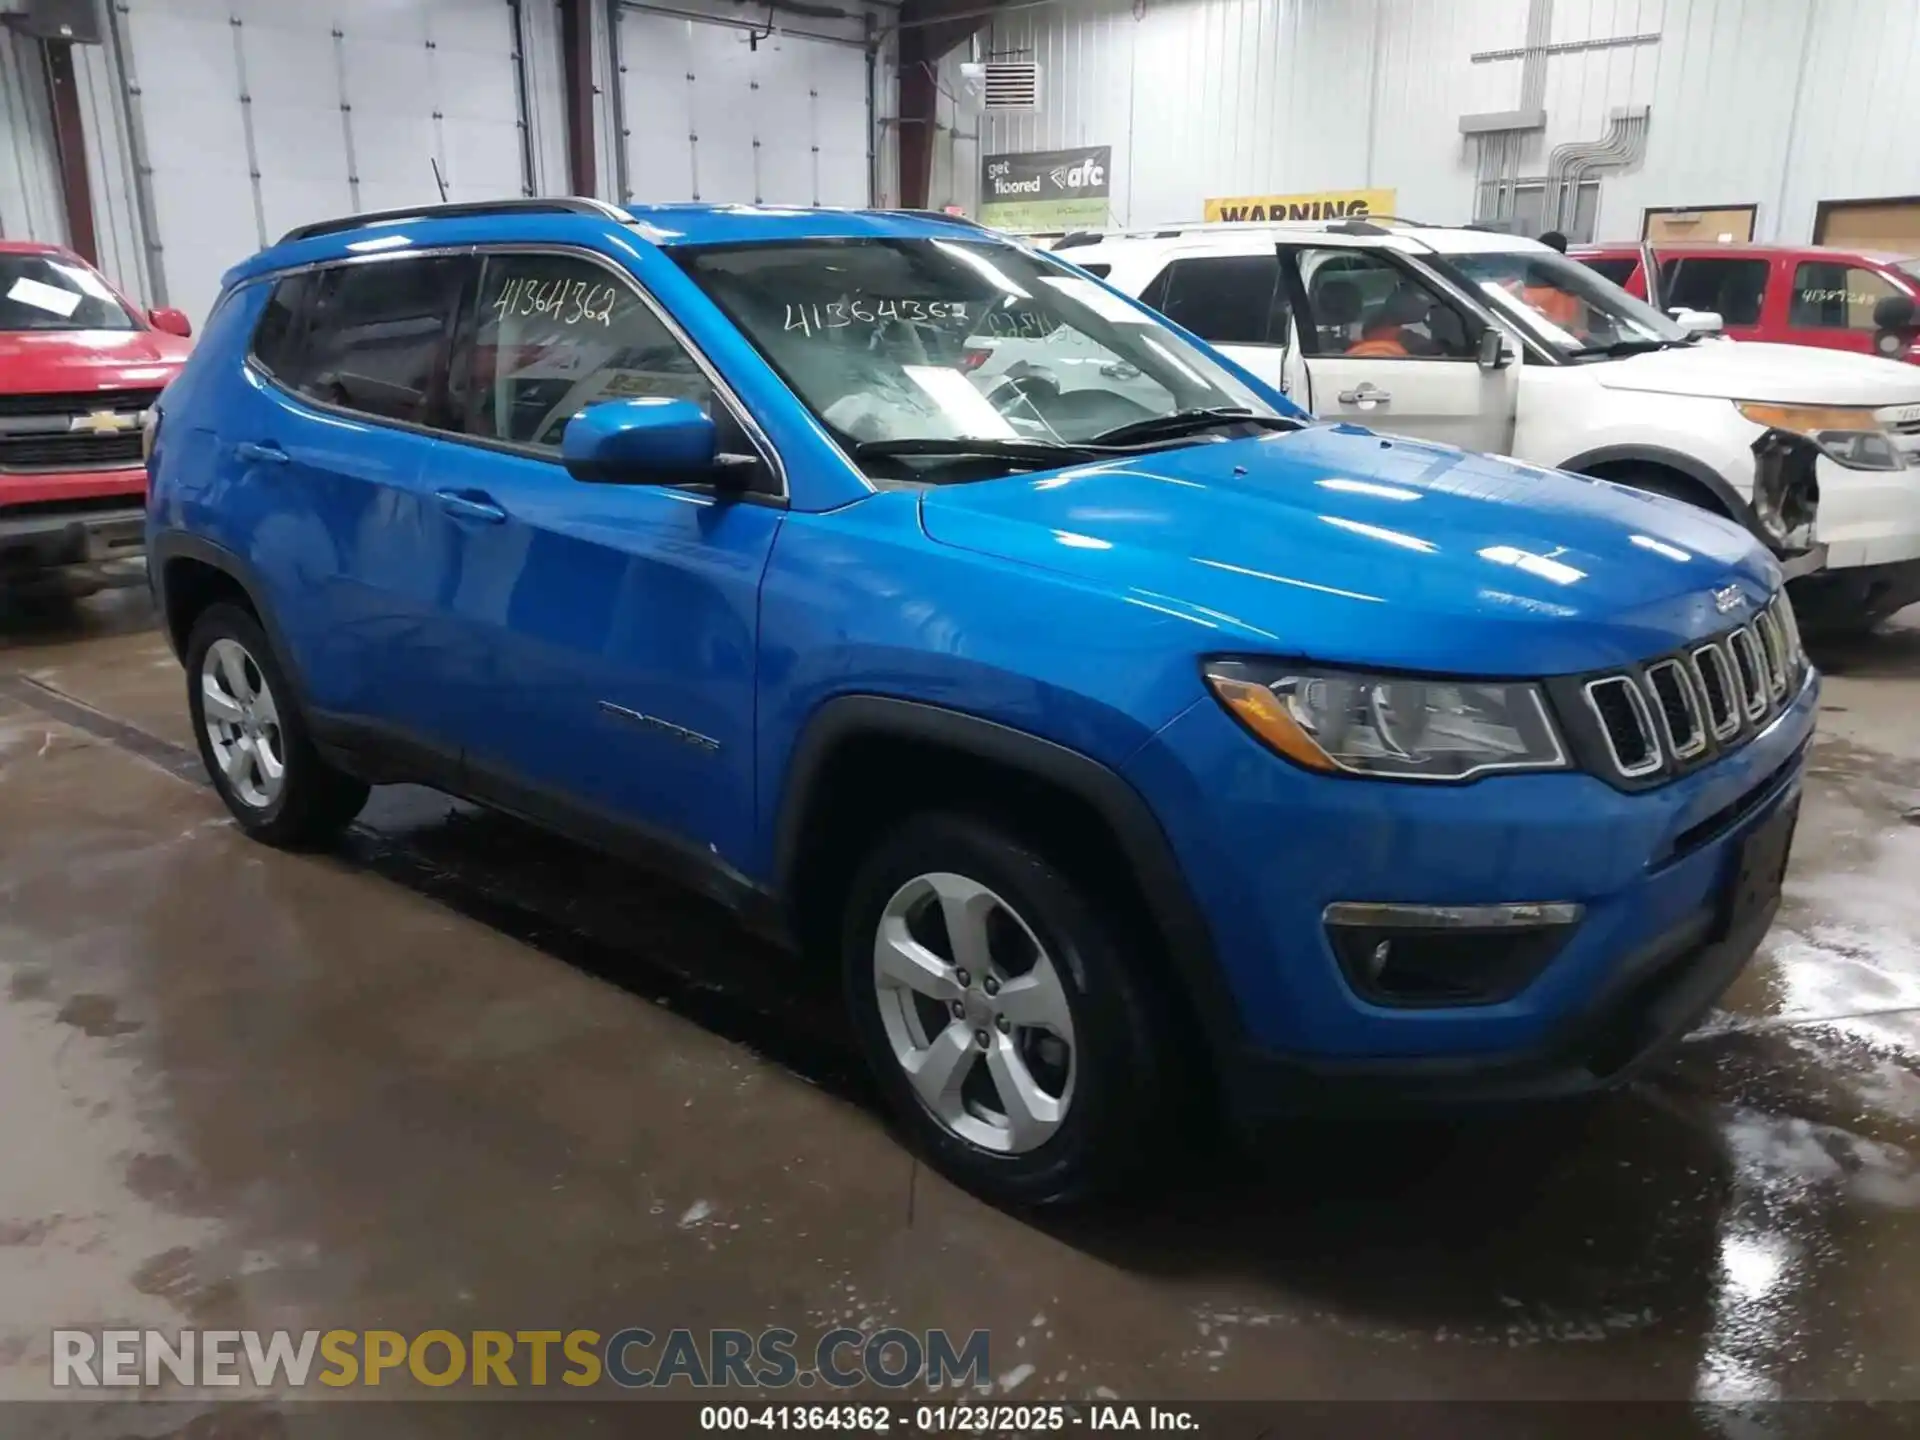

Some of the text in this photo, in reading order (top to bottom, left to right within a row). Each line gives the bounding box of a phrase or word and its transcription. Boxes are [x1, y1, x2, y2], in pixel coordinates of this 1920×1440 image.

[988, 160, 1010, 180] get
[1067, 158, 1104, 188] afc
[995, 175, 1041, 194] floored
[1220, 199, 1369, 222] WARNING
[492, 276, 616, 327] 41364362
